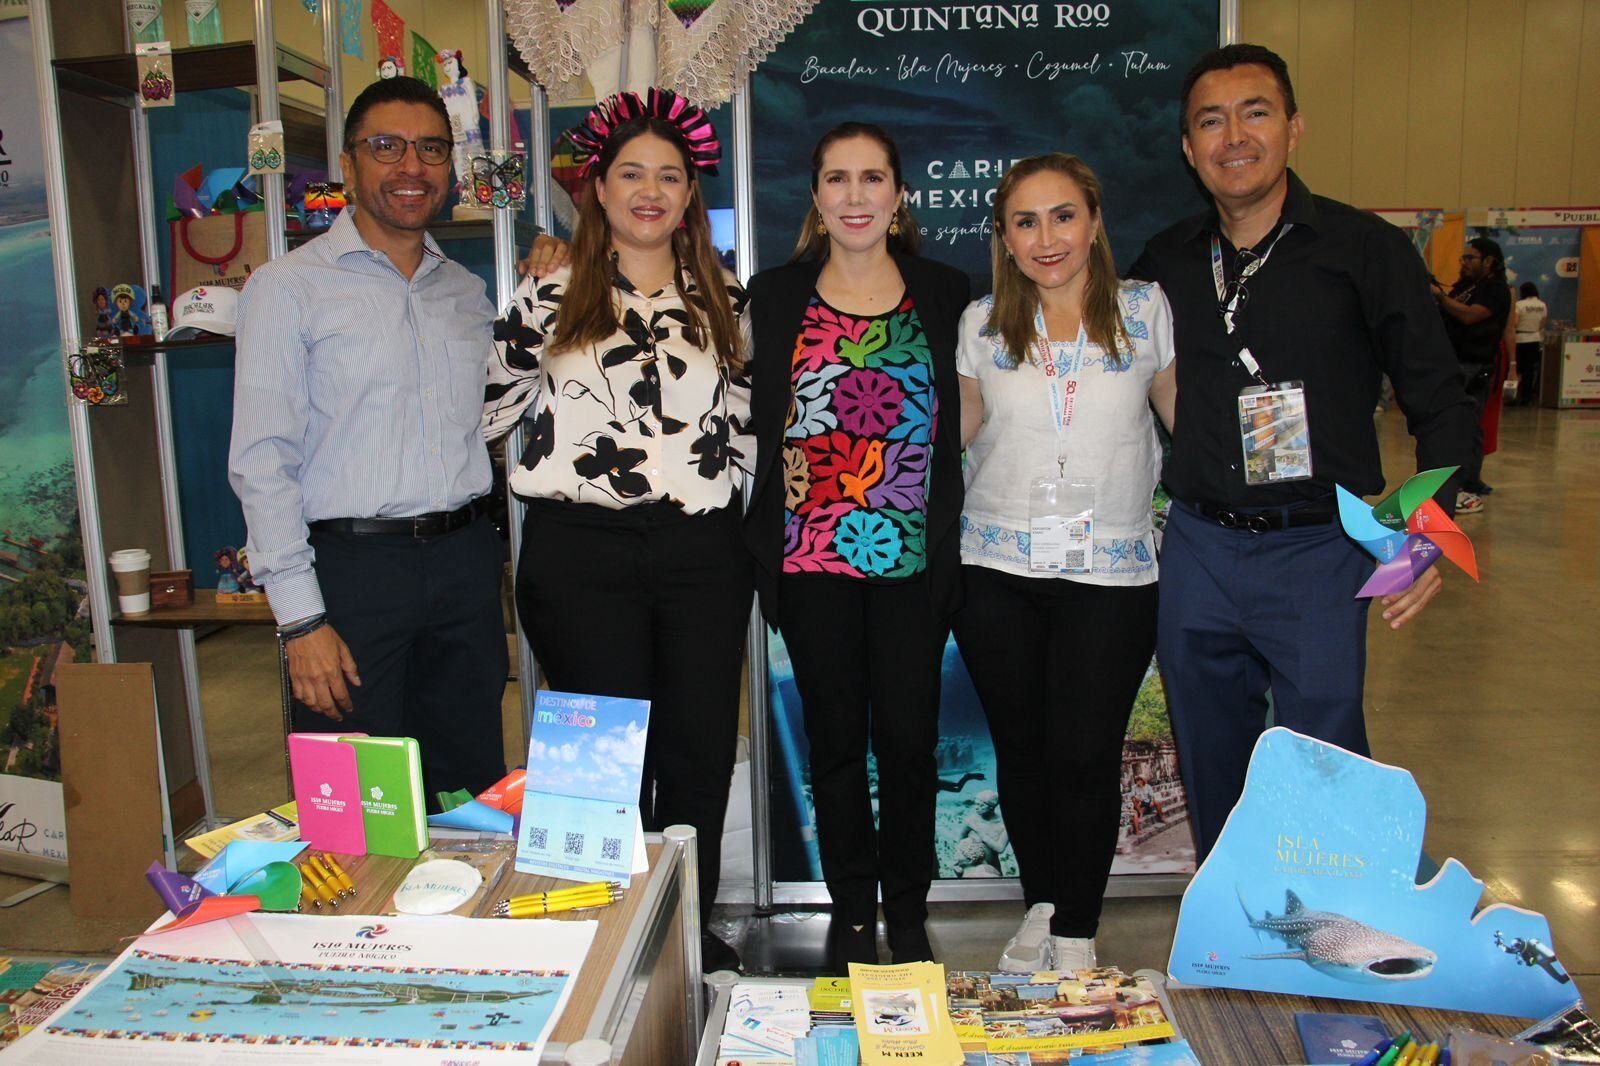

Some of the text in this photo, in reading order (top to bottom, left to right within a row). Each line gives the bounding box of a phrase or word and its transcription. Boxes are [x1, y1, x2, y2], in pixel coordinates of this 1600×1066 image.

[800, 50, 1172, 84] Bacalar Isla Mujeres Cozumel Tulum
[1277, 832, 1320, 850] ISLA
[1276, 848, 1366, 868] MUJERES
